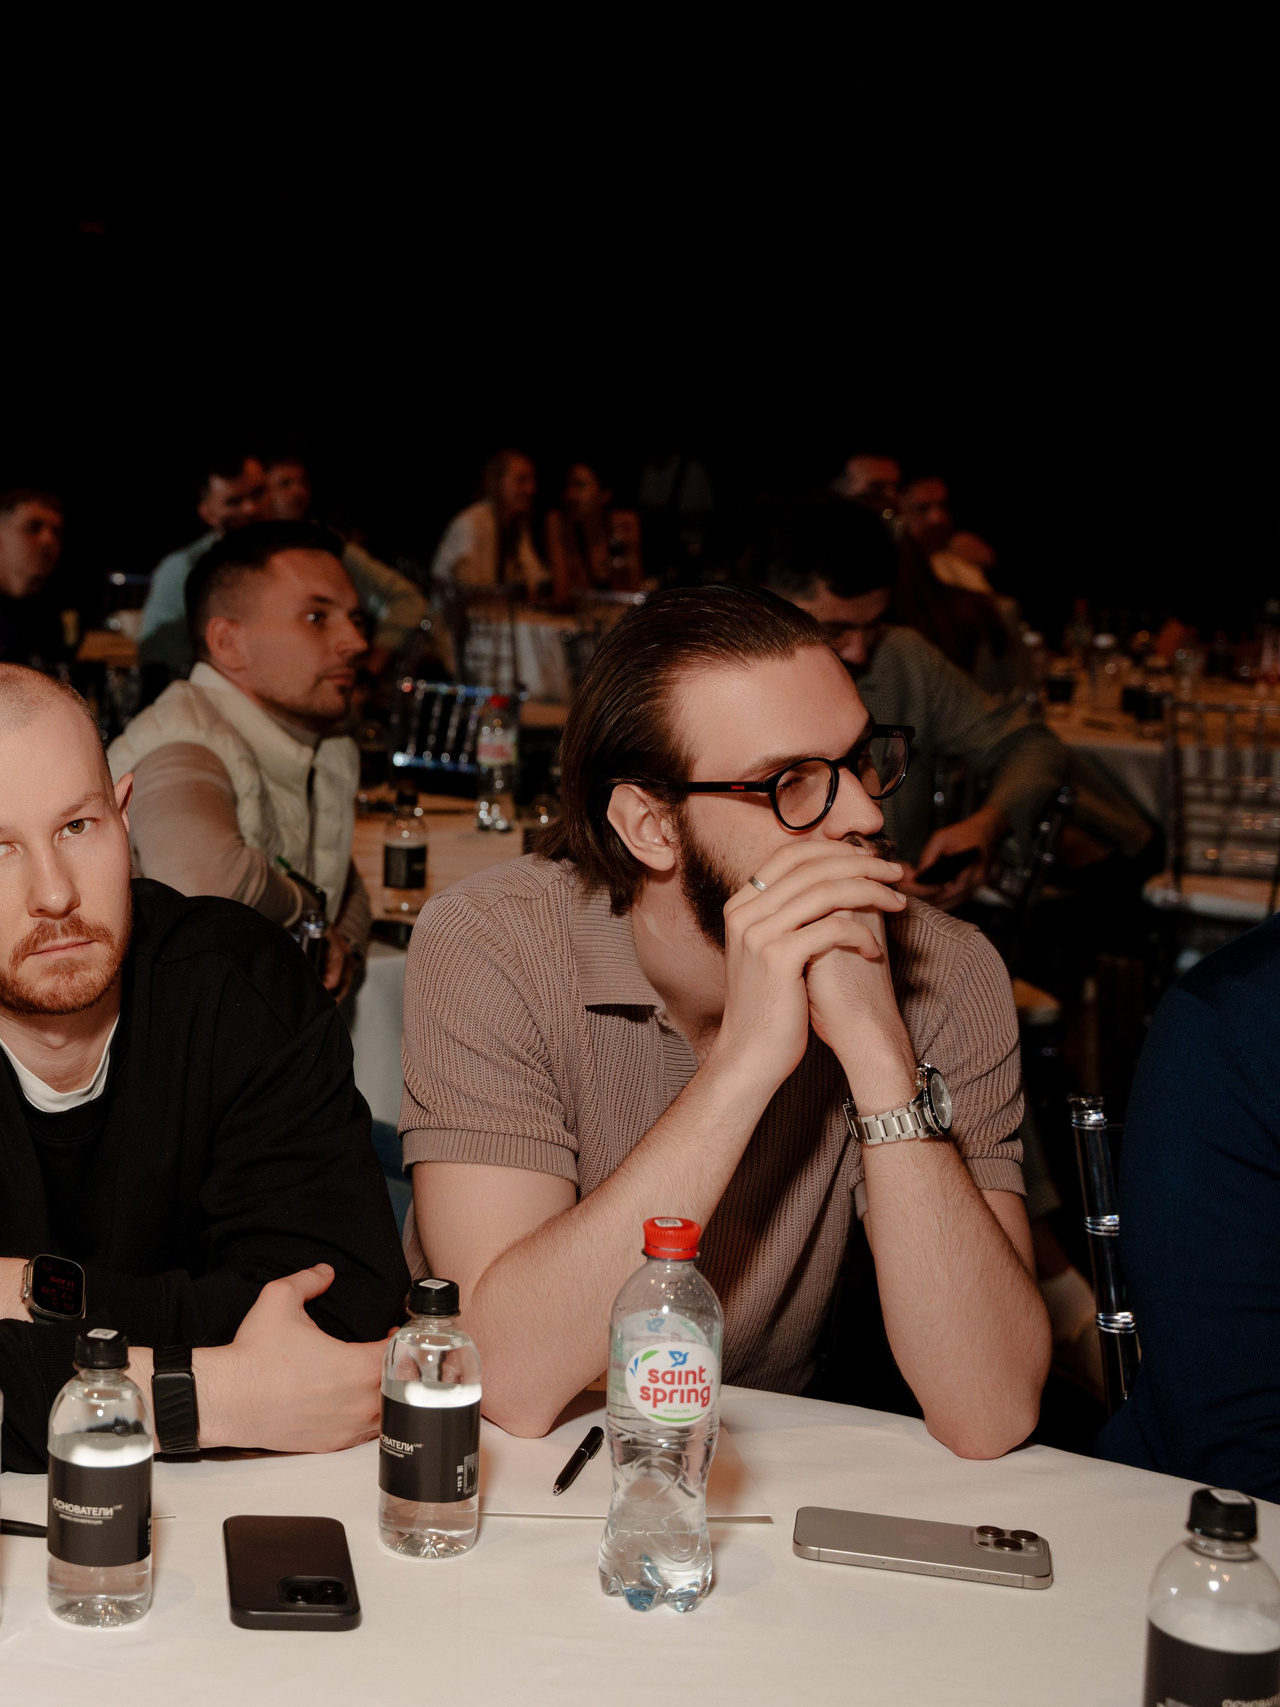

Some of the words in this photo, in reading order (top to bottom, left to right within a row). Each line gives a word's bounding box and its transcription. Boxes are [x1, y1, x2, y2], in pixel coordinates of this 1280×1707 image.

[647, 1365, 707, 1385] saint
[639, 1385, 711, 1408] spring
[52, 1497, 114, 1516] ОСНОВАТЕЛИ
